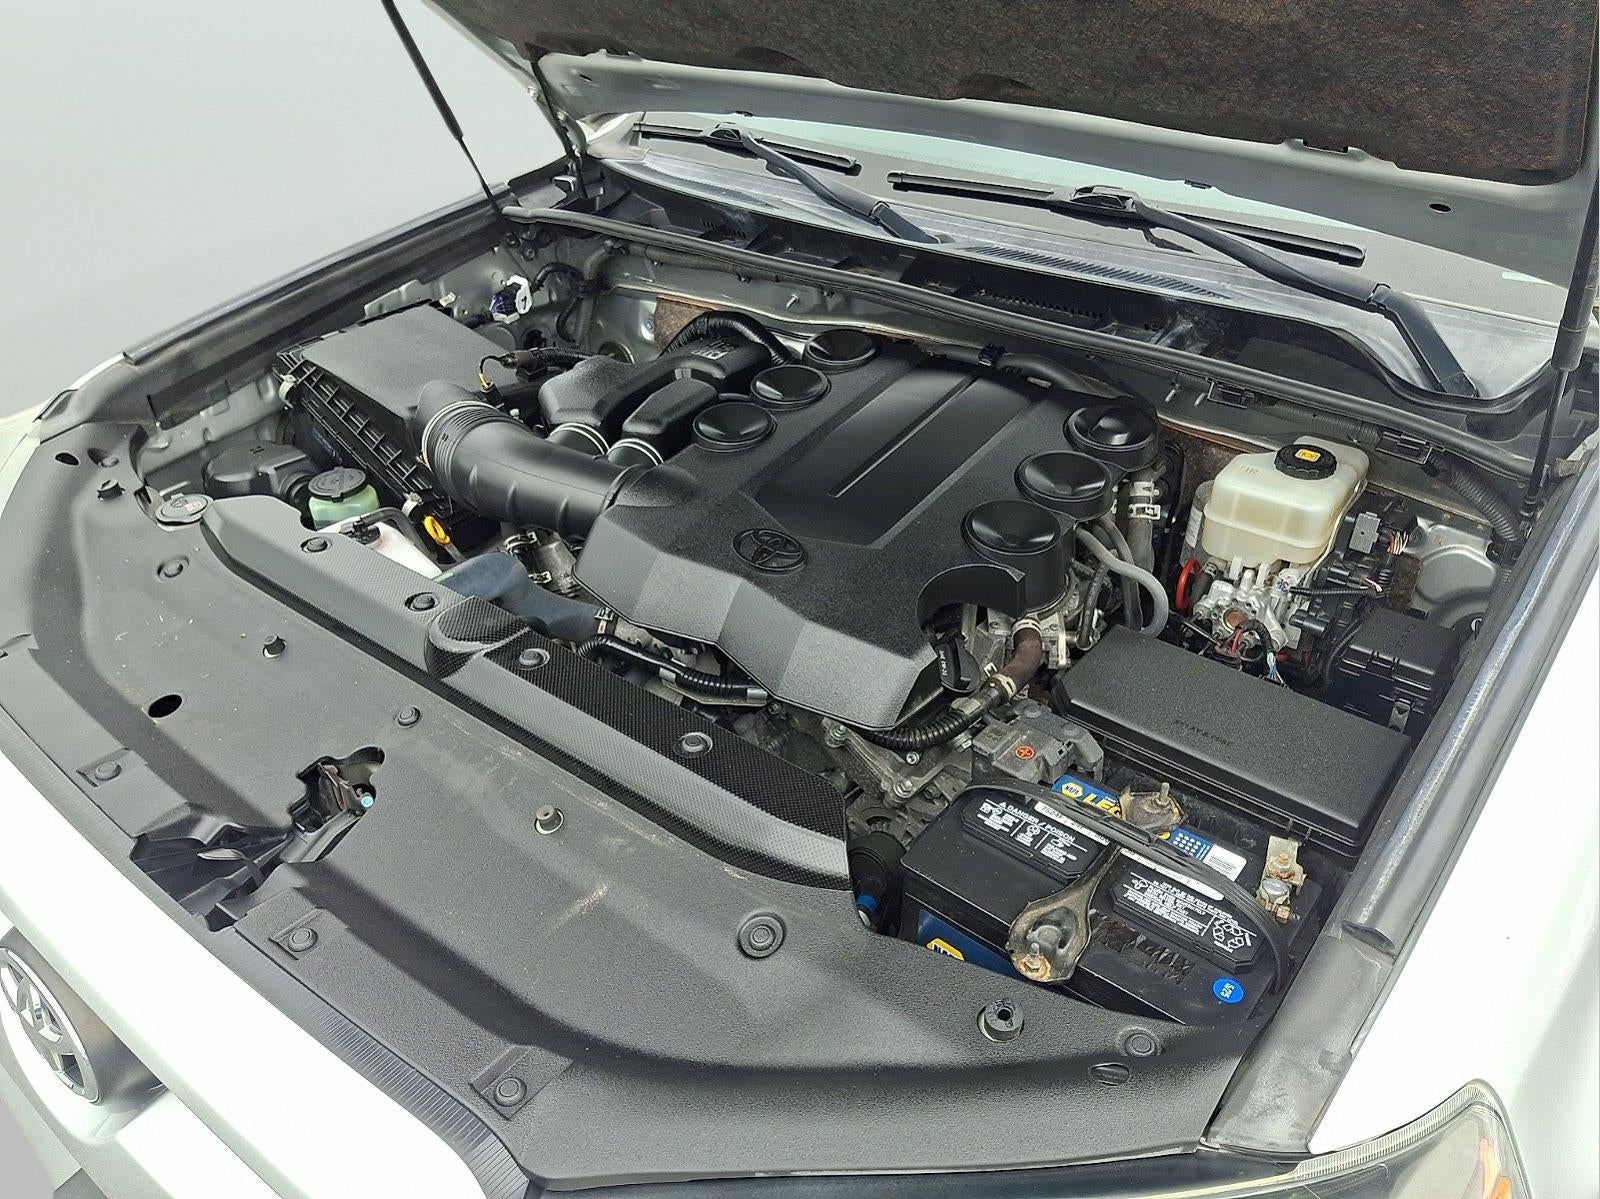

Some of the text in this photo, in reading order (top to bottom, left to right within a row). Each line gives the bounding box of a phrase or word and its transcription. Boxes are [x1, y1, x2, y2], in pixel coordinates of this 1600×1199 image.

[1064, 783, 1080, 796] NAPA
[1006, 804, 1040, 825] DANGER
[1045, 823, 1076, 843] POISON
